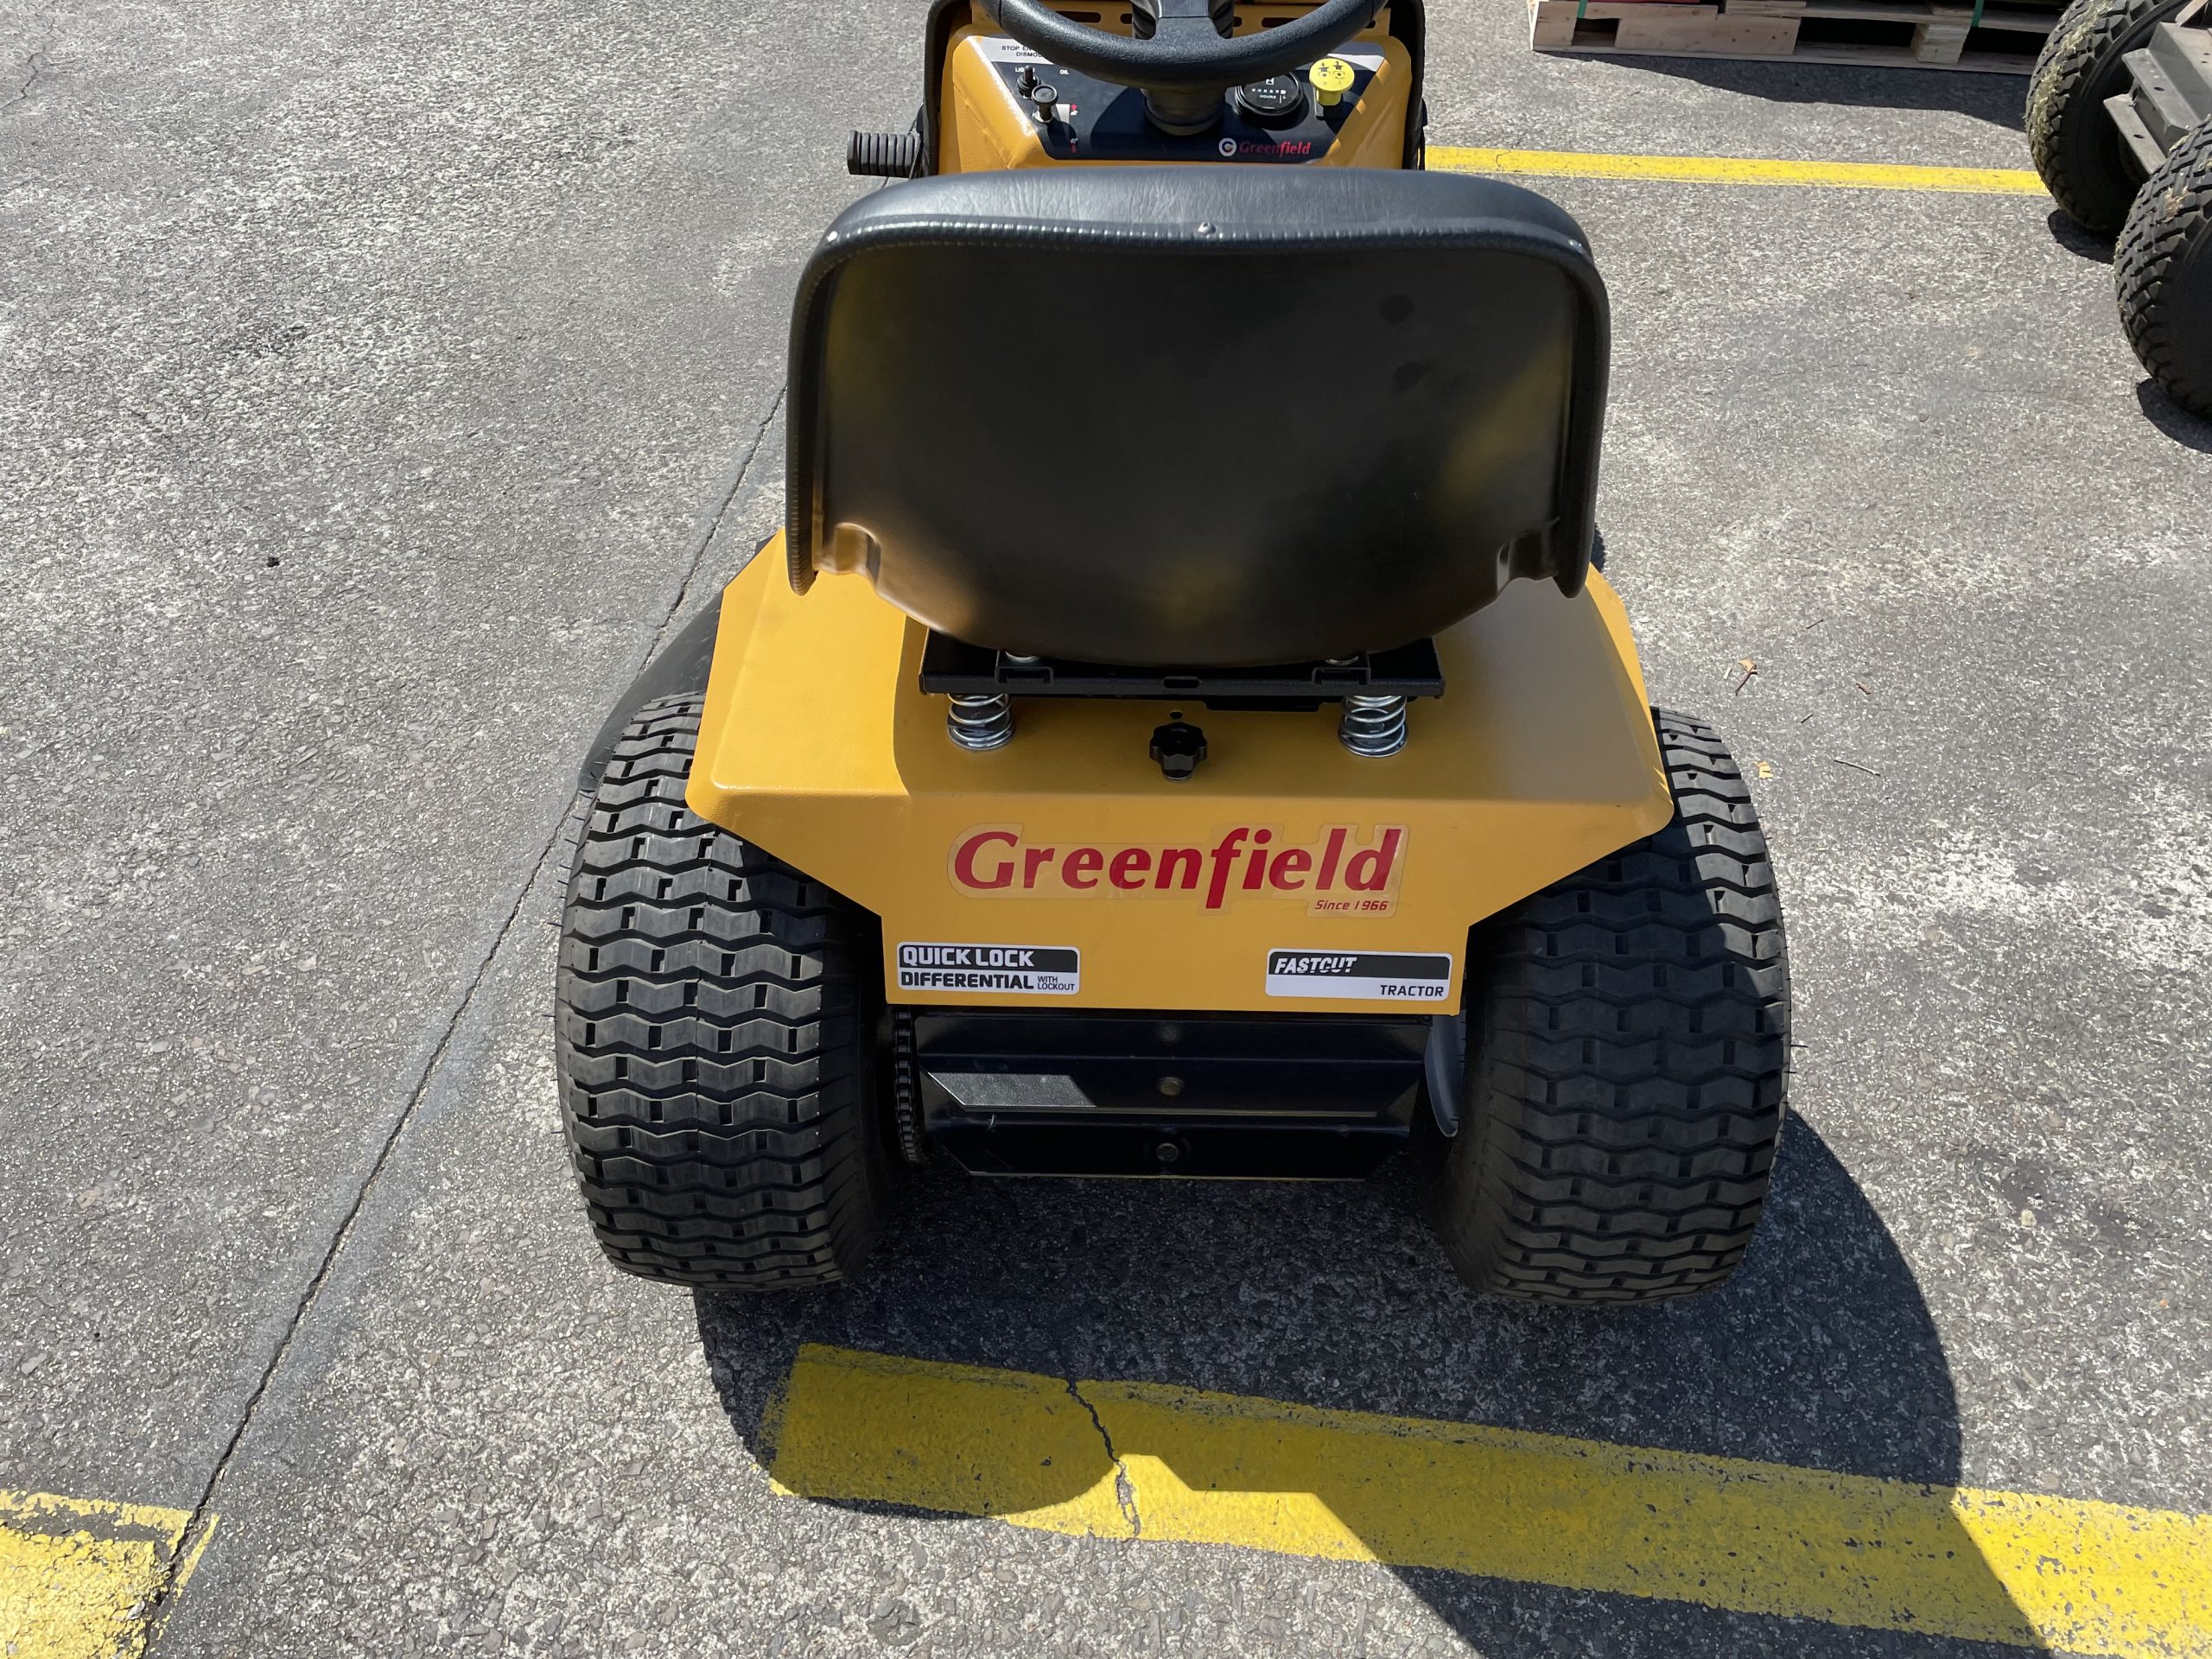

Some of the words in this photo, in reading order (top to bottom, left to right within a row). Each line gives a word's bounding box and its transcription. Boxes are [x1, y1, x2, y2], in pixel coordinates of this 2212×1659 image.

[1239, 141, 1312, 157] Greenfield
[954, 828, 1402, 910] Greenfield
[1314, 899, 1350, 911] Since
[1354, 900, 1389, 911] 1966
[903, 946, 971, 967] QUICK
[975, 949, 1034, 968] LOCK
[1274, 957, 1357, 975] FASTCUT
[900, 971, 1034, 990] DIFFERENTIAL
[1037, 976, 1058, 984] WITH
[1037, 982, 1075, 992] LOCKOUT
[1380, 984, 1444, 997] TRACTOR
